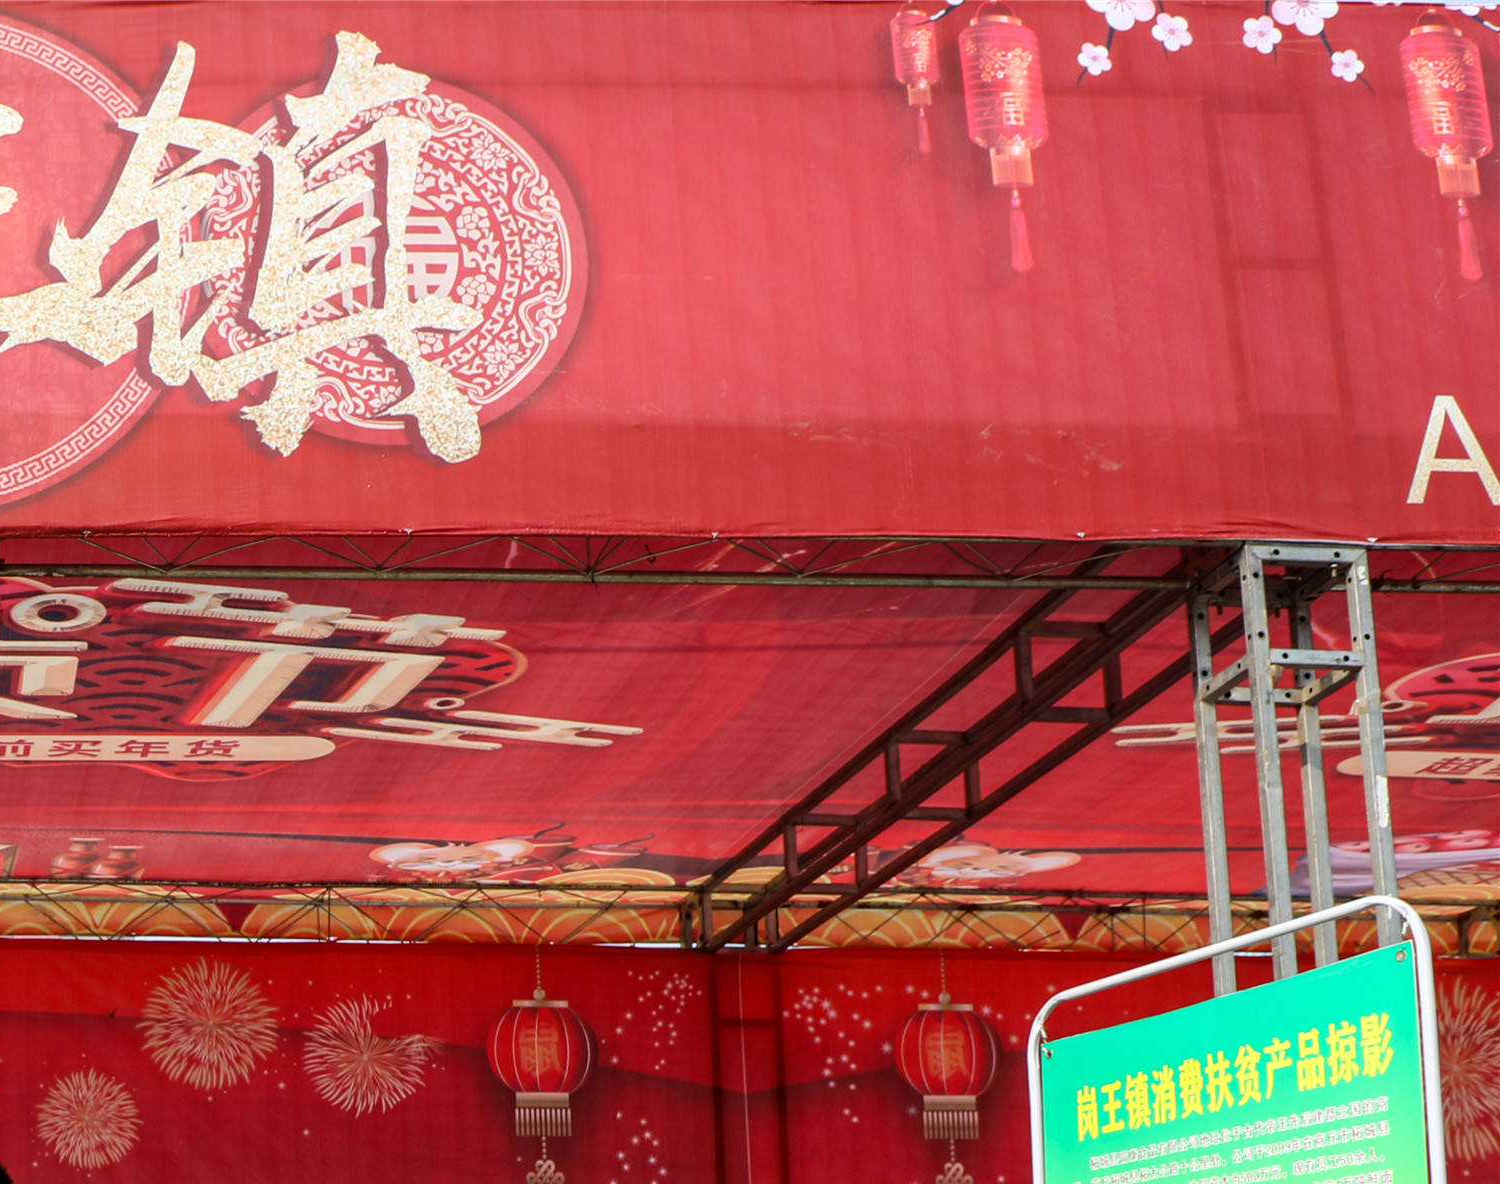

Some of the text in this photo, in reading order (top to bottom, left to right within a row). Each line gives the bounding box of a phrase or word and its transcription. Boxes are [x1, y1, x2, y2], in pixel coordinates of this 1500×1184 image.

[1076, 1012, 1395, 1142] 岗王镇消费扶贫产品掠影
